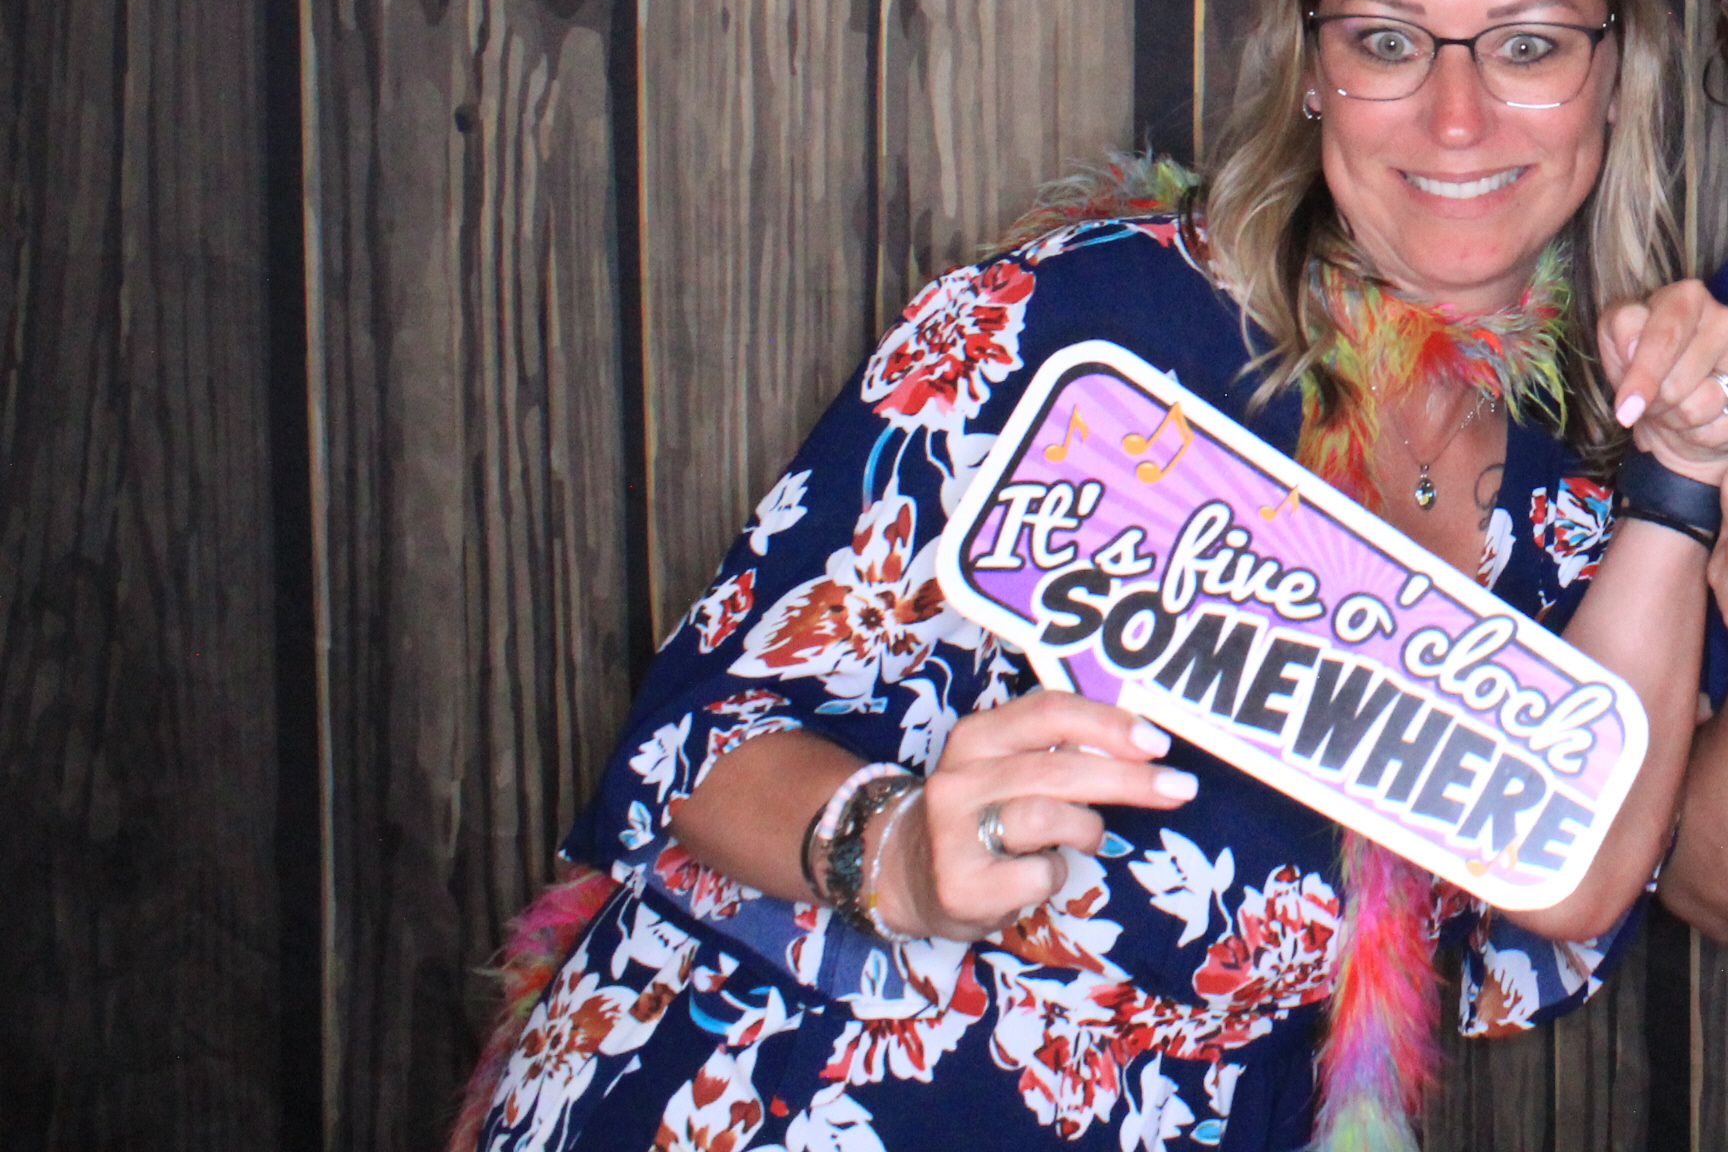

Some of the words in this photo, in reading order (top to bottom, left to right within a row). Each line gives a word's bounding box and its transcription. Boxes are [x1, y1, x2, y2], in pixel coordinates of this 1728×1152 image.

[974, 482, 1153, 576] It's
[1164, 501, 1325, 614] five
[1332, 572, 1616, 778] o'clock
[1040, 572, 1596, 872] SOMEWHERE
